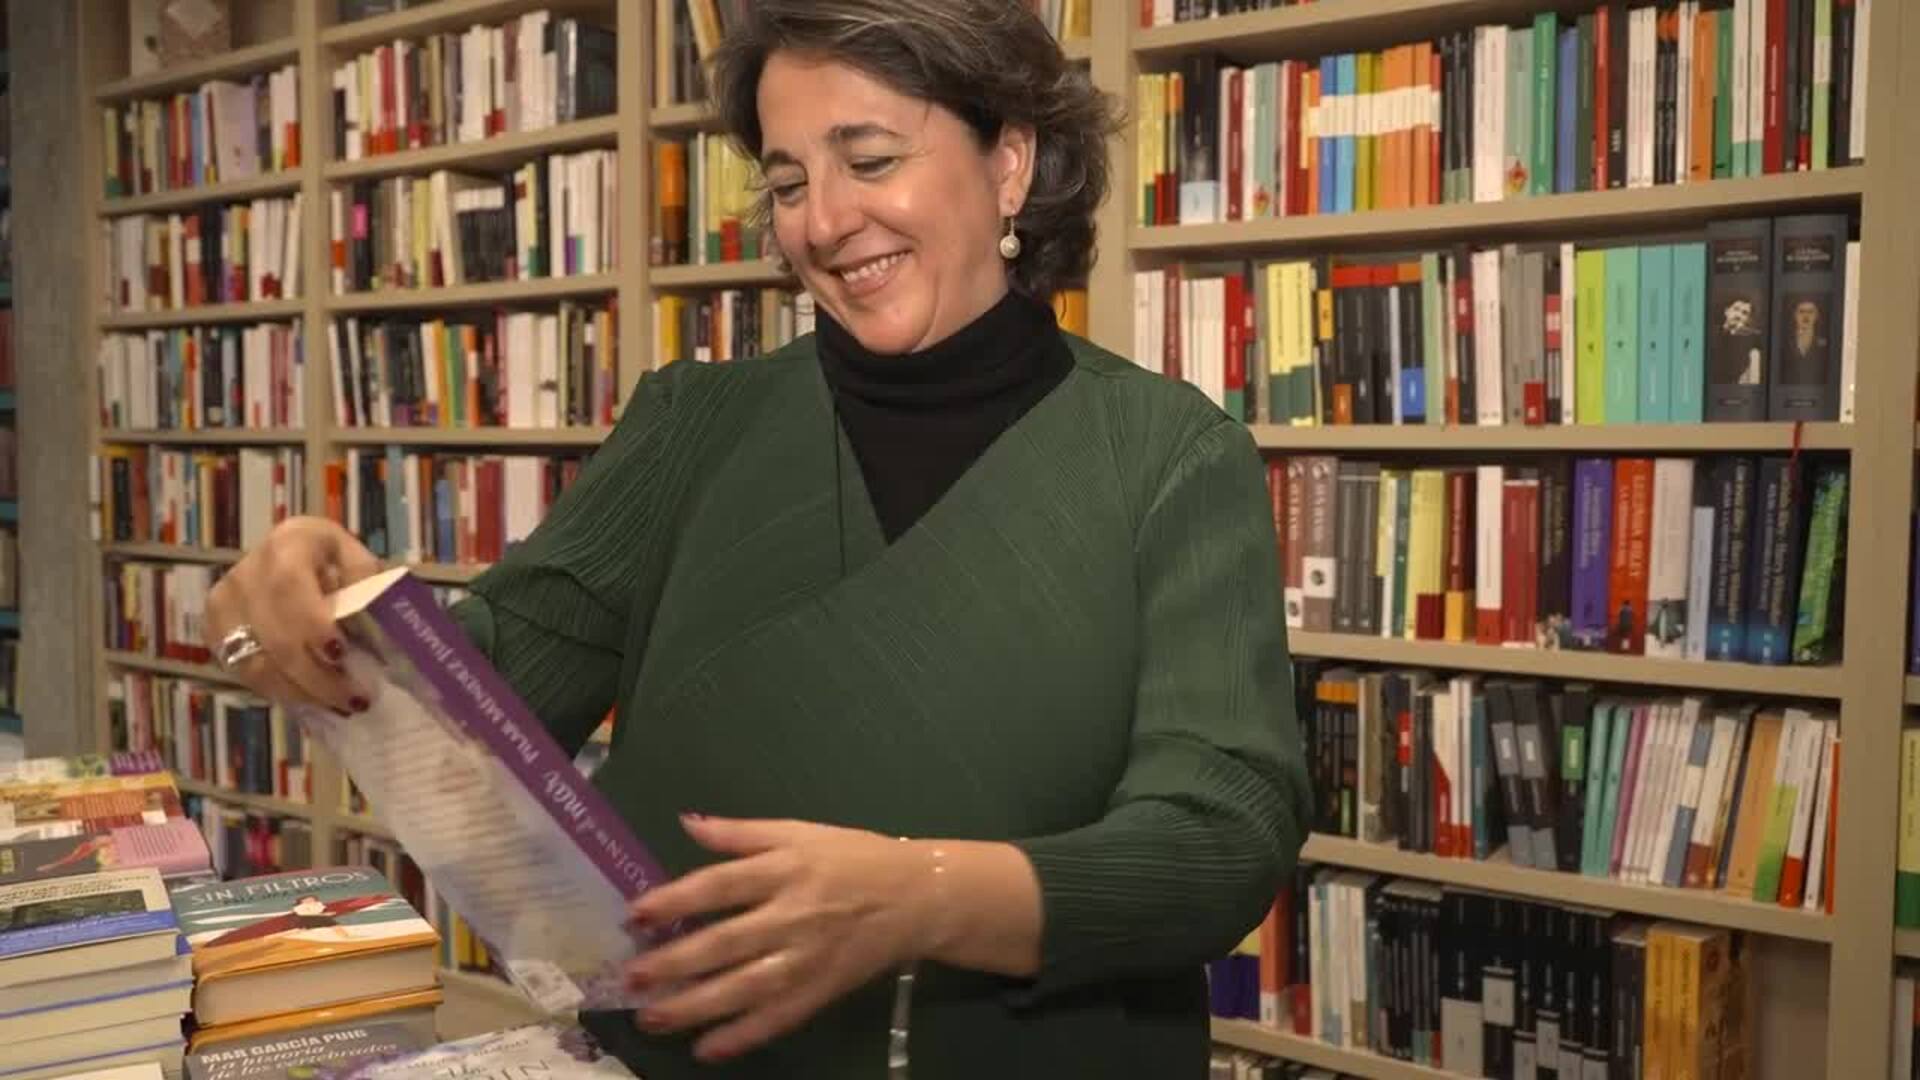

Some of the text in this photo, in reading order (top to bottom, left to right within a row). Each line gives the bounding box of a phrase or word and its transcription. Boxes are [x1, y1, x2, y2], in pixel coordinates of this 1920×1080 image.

[501, 719, 540, 765] PILAR
[191, 888, 234, 906] SIN
[247, 872, 371, 896] FILTROS
[201, 1028, 368, 1064] MAR GARCÍA PUIG
